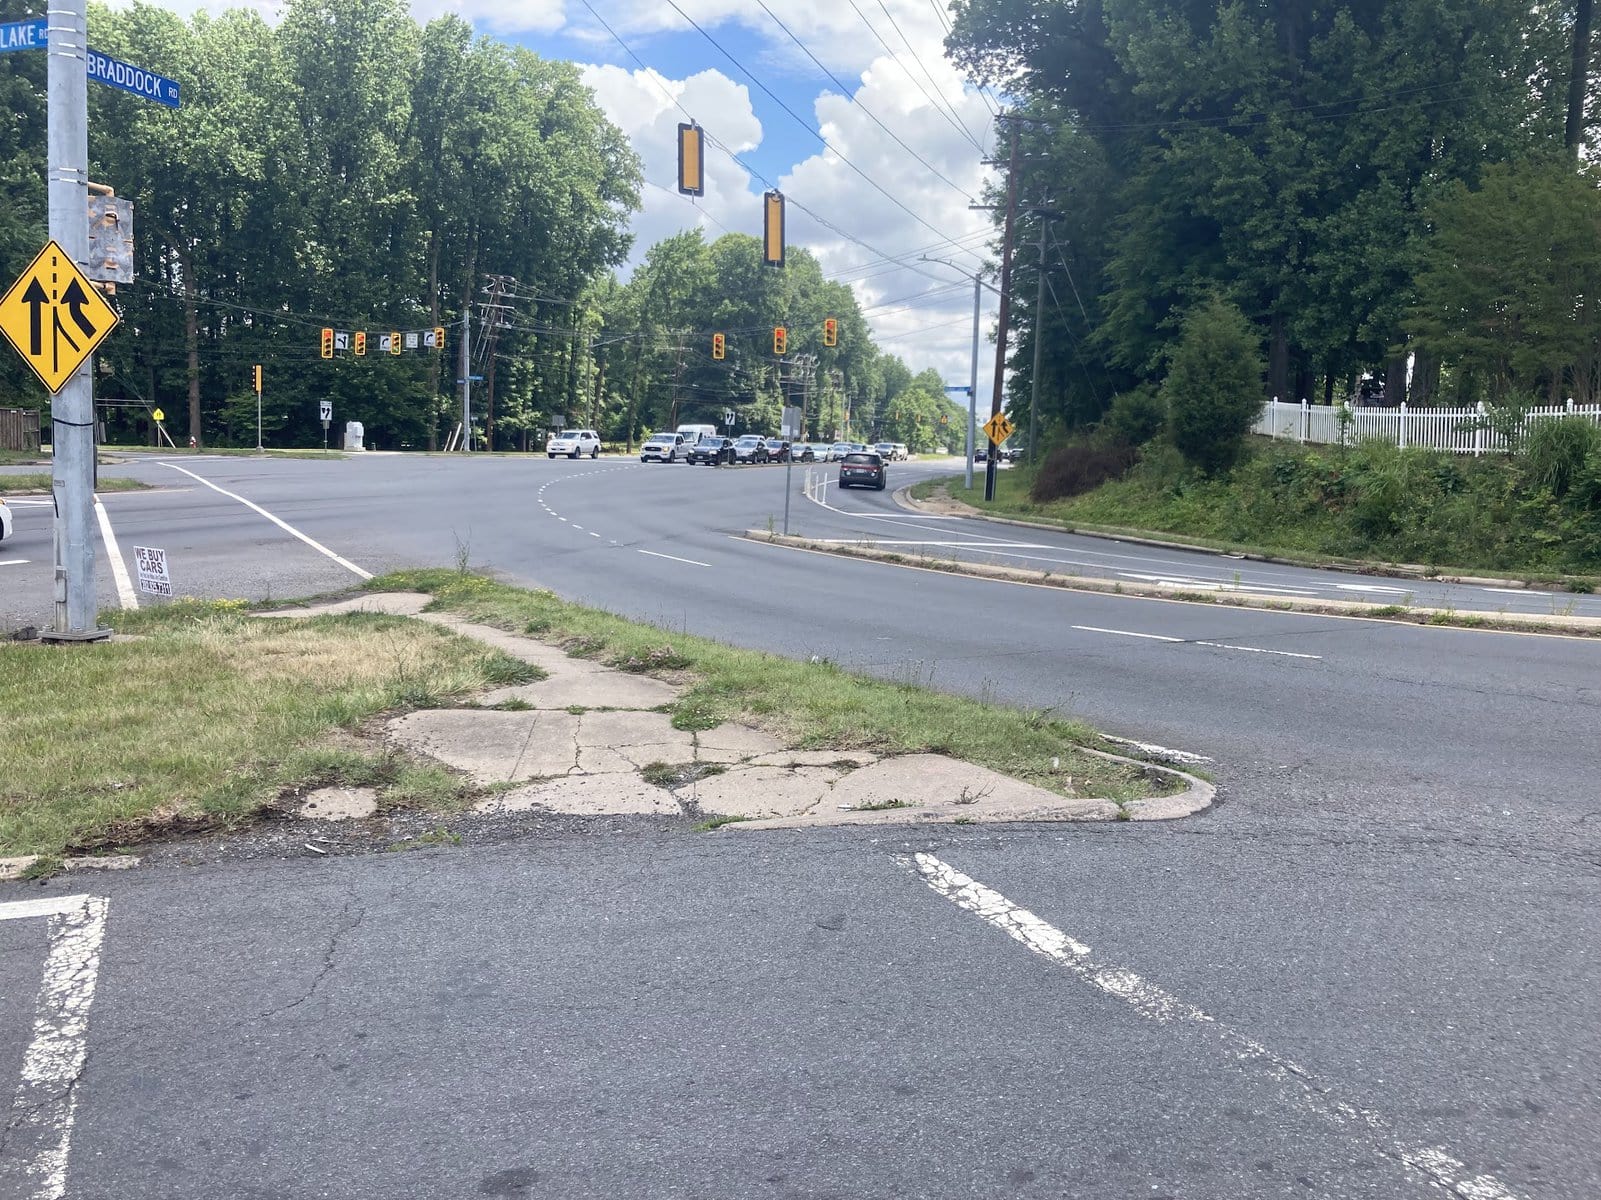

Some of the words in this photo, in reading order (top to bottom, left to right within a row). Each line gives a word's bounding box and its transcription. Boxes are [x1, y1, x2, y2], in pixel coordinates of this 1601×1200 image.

[0, 25, 36, 48] LAKE
[87, 53, 162, 98] BRADDOCK
[168, 86, 178, 98] RD
[134, 547, 147, 560] WE
[147, 549, 164, 562] BUY
[140, 559, 164, 574] CARS
